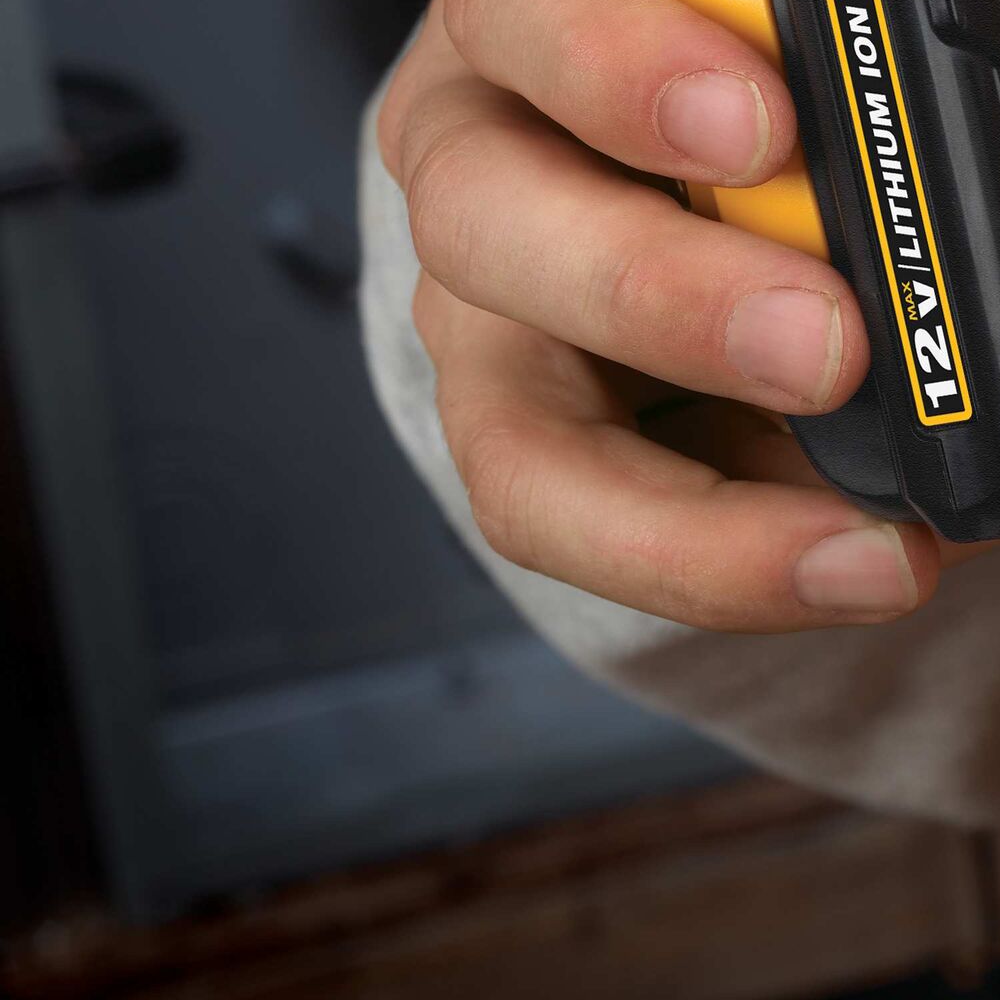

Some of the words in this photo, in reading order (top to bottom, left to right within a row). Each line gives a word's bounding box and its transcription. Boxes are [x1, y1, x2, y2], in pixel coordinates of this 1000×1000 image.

[845, 5, 882, 78] ION
[864, 92, 922, 259] LITHIUM
[901, 281, 918, 321] MAX
